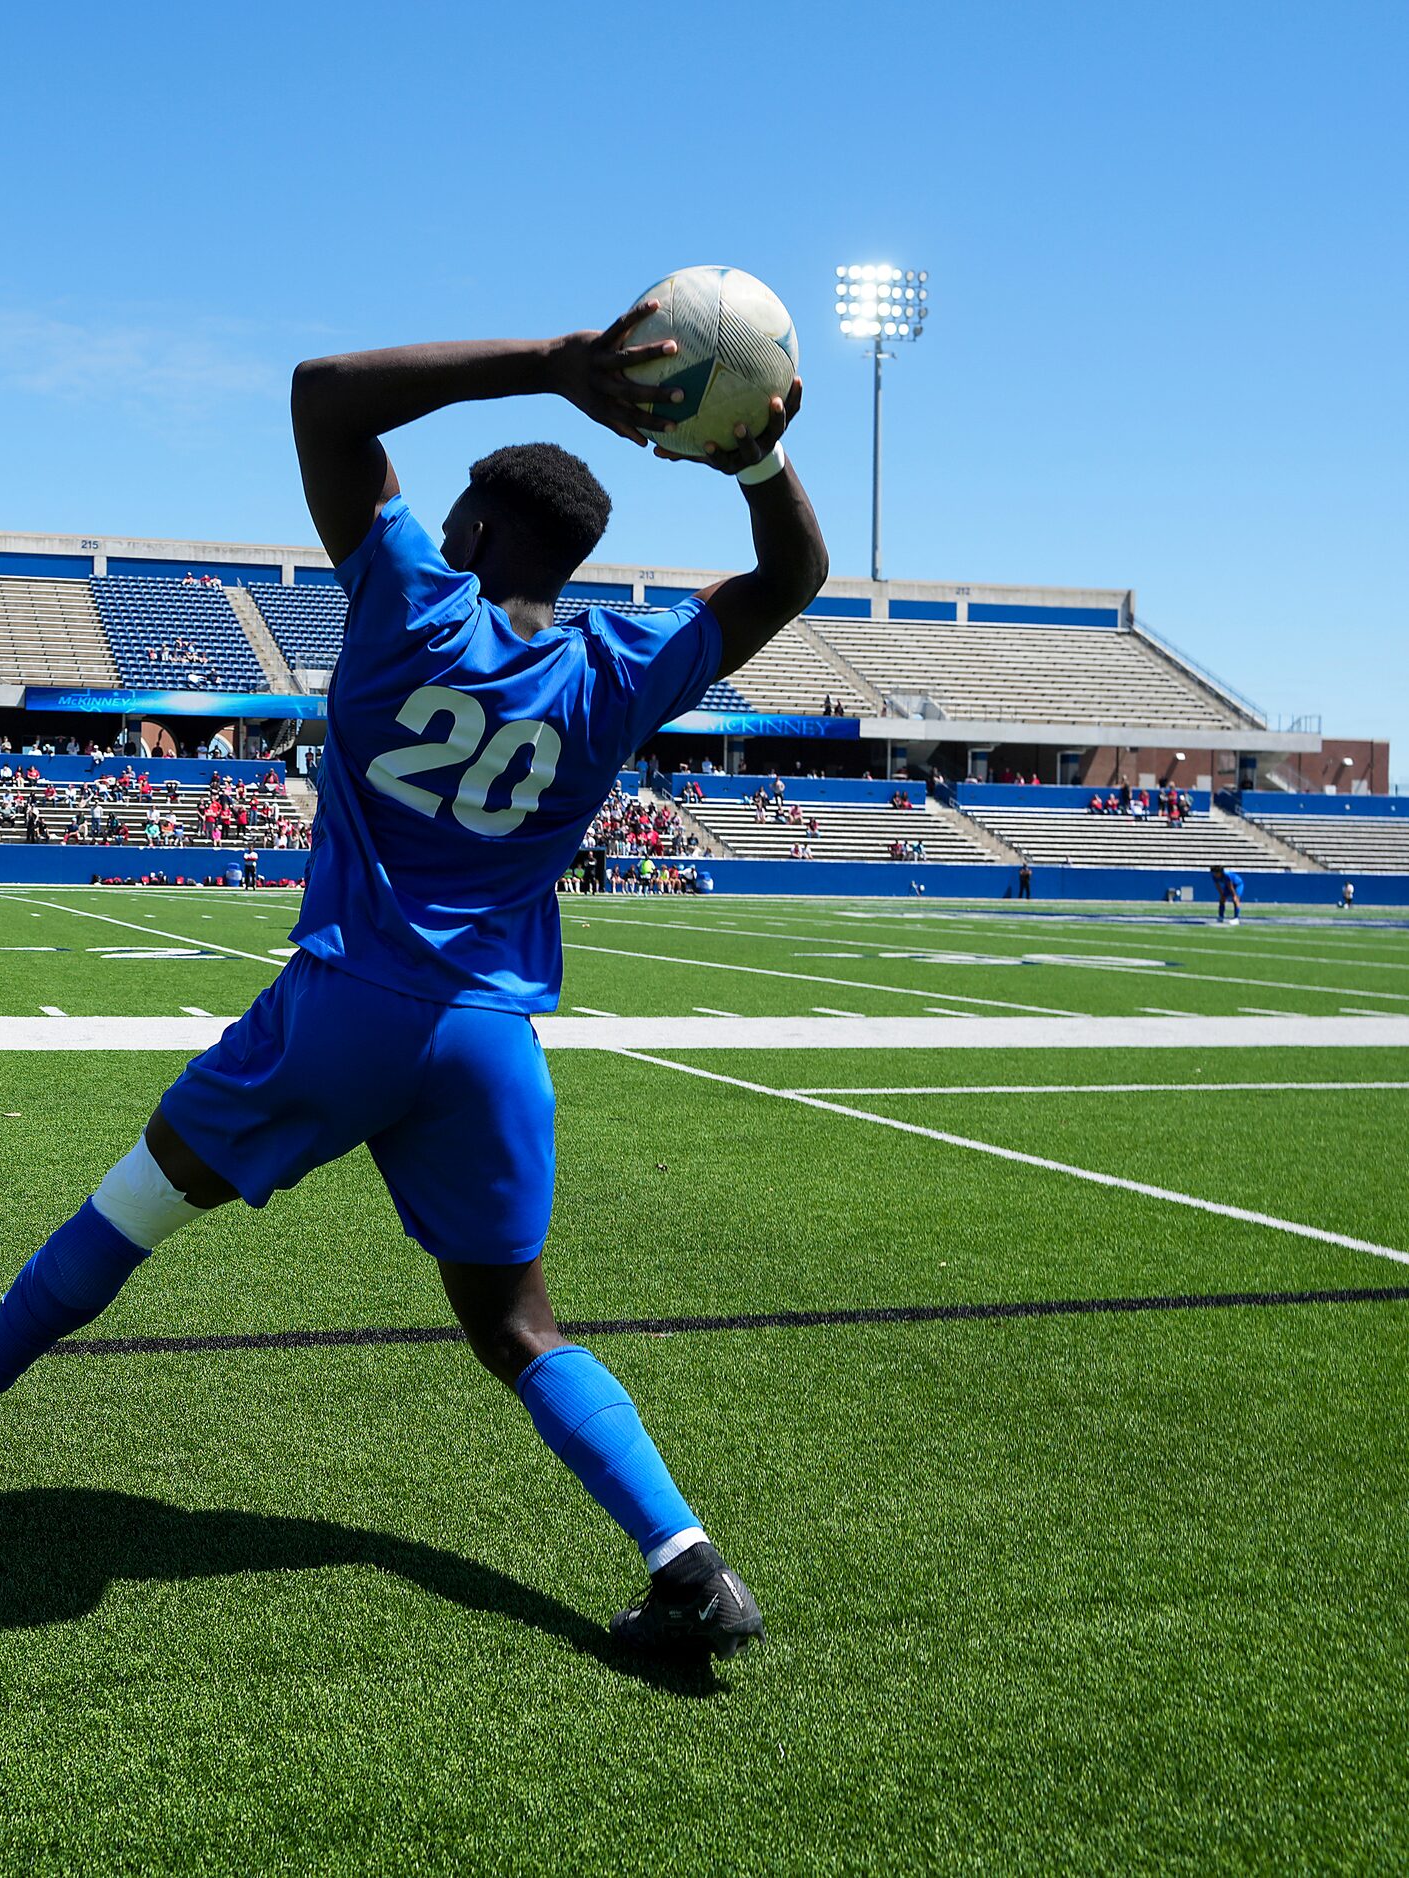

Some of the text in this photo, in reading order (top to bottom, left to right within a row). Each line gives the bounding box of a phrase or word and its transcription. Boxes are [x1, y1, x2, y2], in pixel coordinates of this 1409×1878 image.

[81, 539, 99, 550] 215
[639, 570, 655, 580] 213
[366, 685, 562, 836] 20
